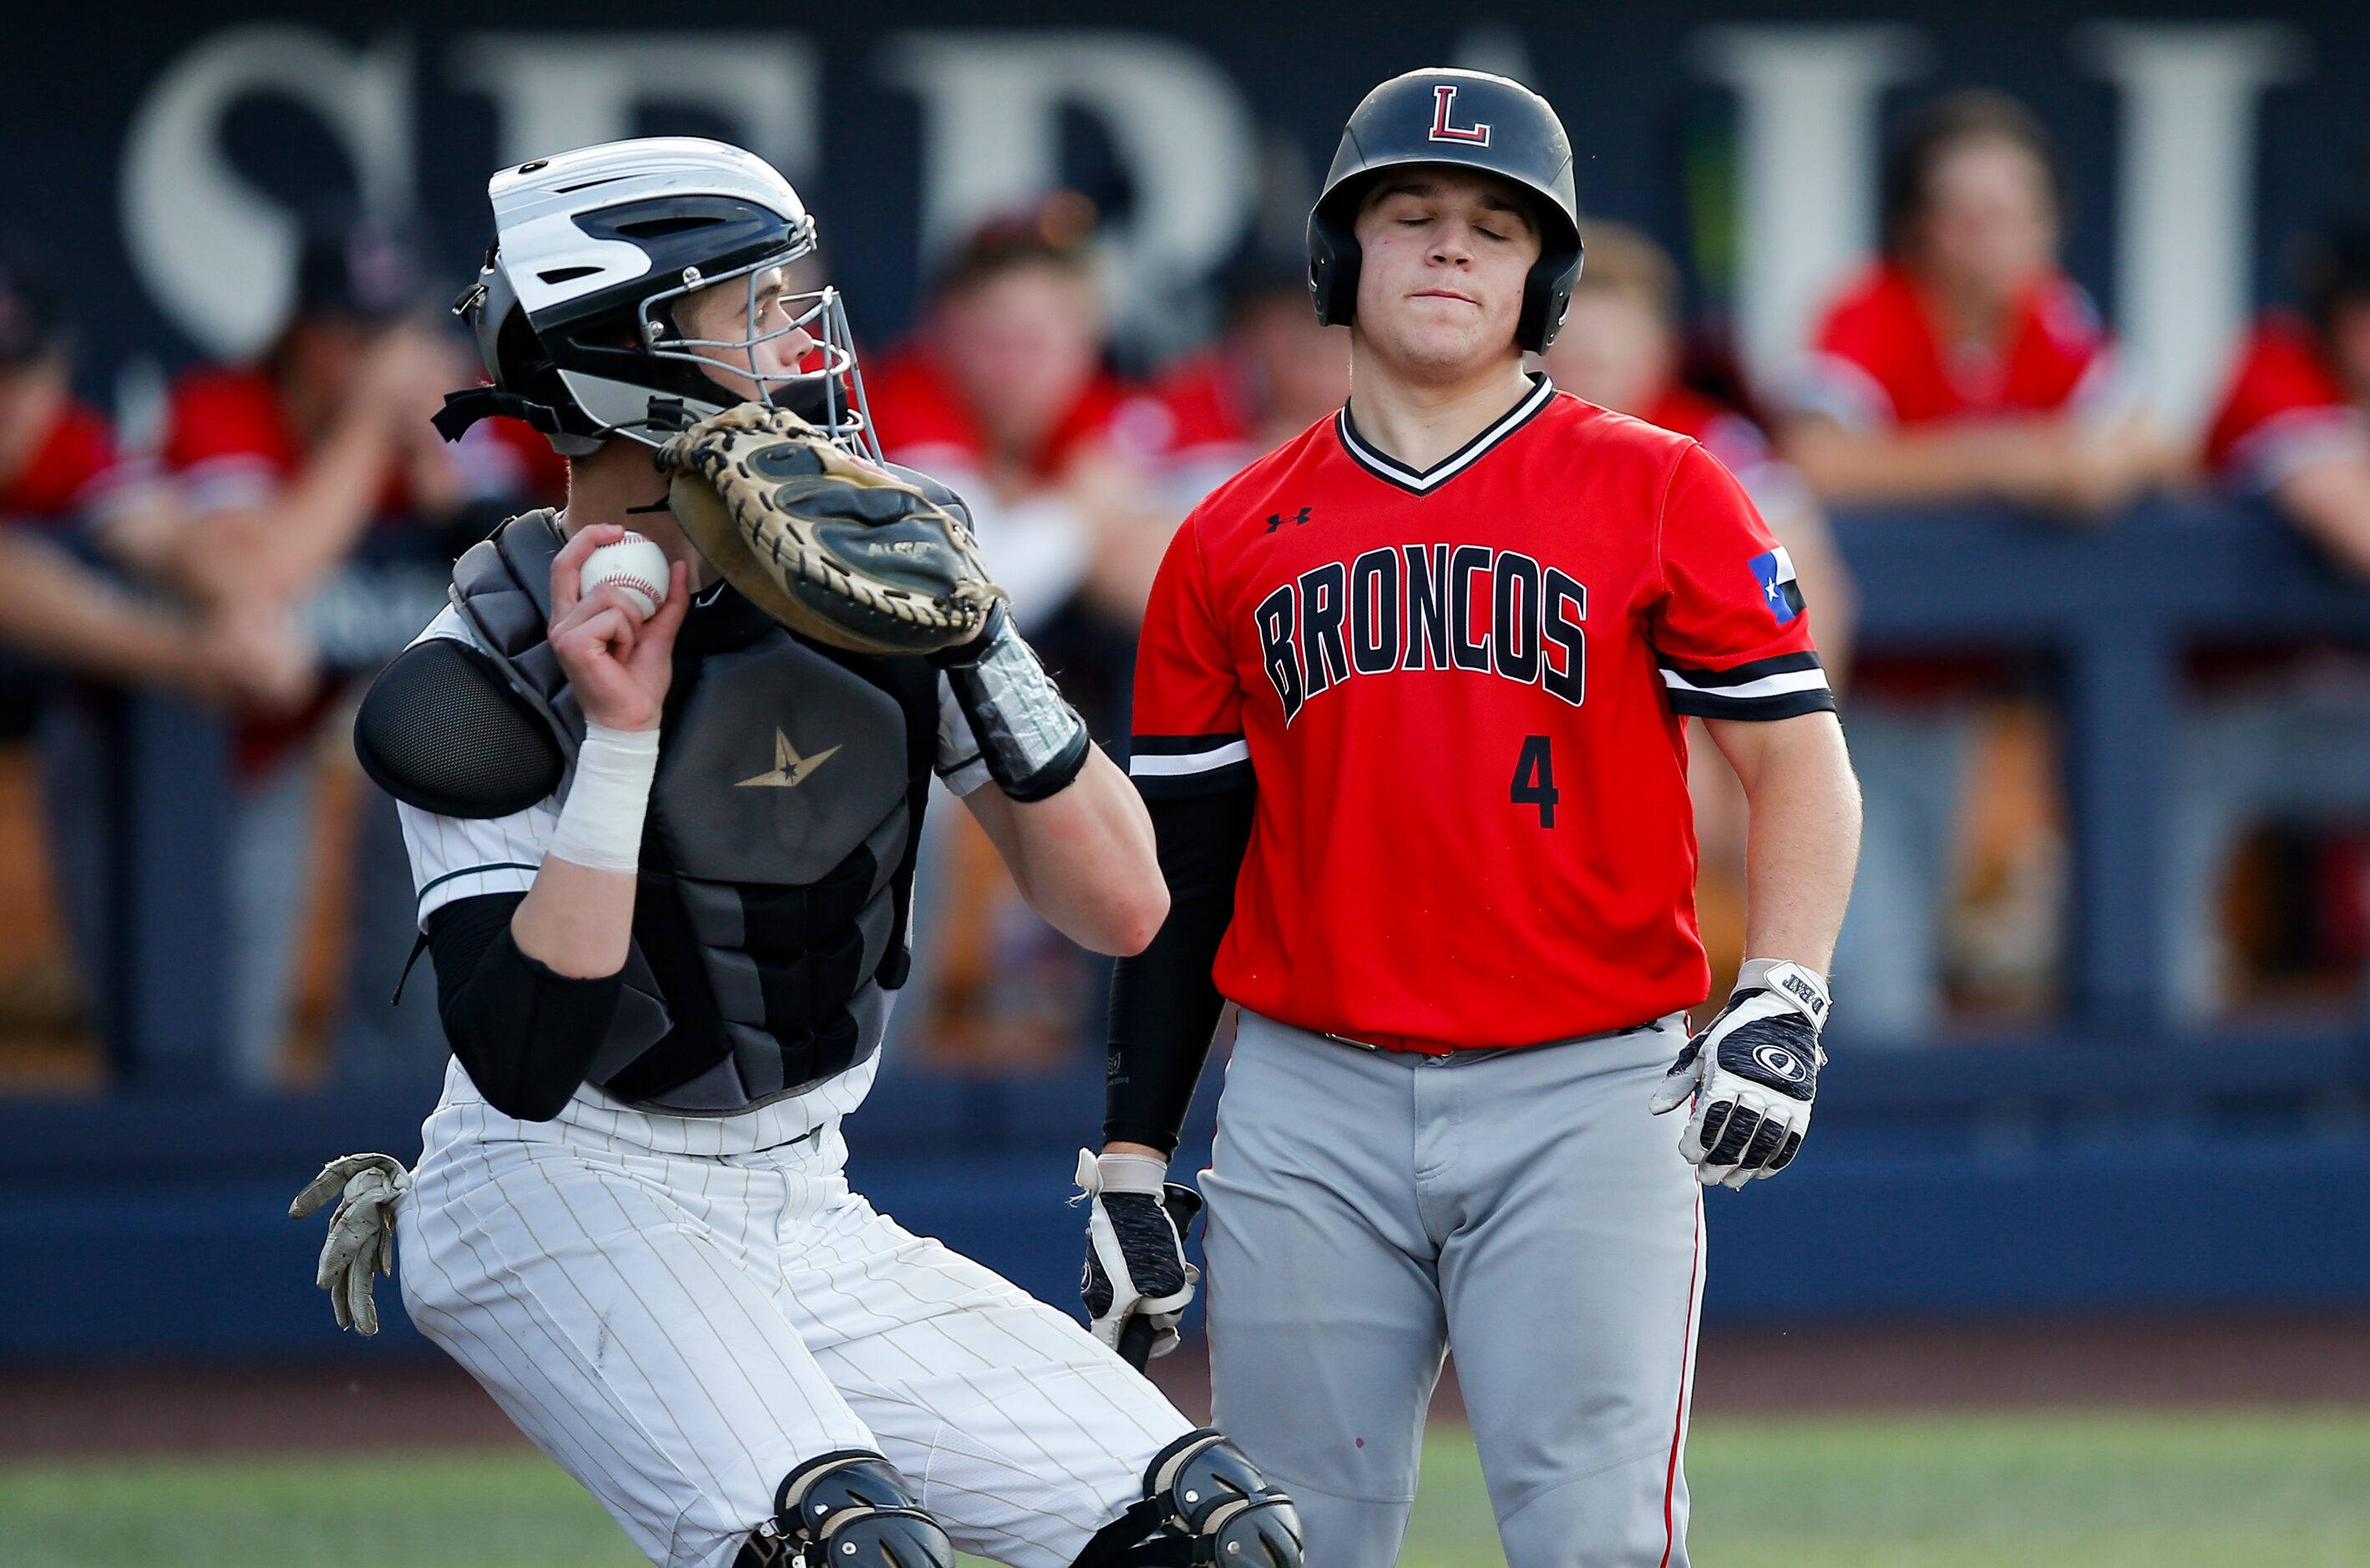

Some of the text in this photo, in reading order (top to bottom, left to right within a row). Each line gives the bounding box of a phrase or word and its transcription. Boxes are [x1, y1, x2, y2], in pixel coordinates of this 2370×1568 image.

[1427, 84, 1491, 148] L
[1253, 542, 1588, 731] BRONCOS
[1509, 735, 1560, 829] 4
[1781, 973, 1825, 1015] D-BAT
